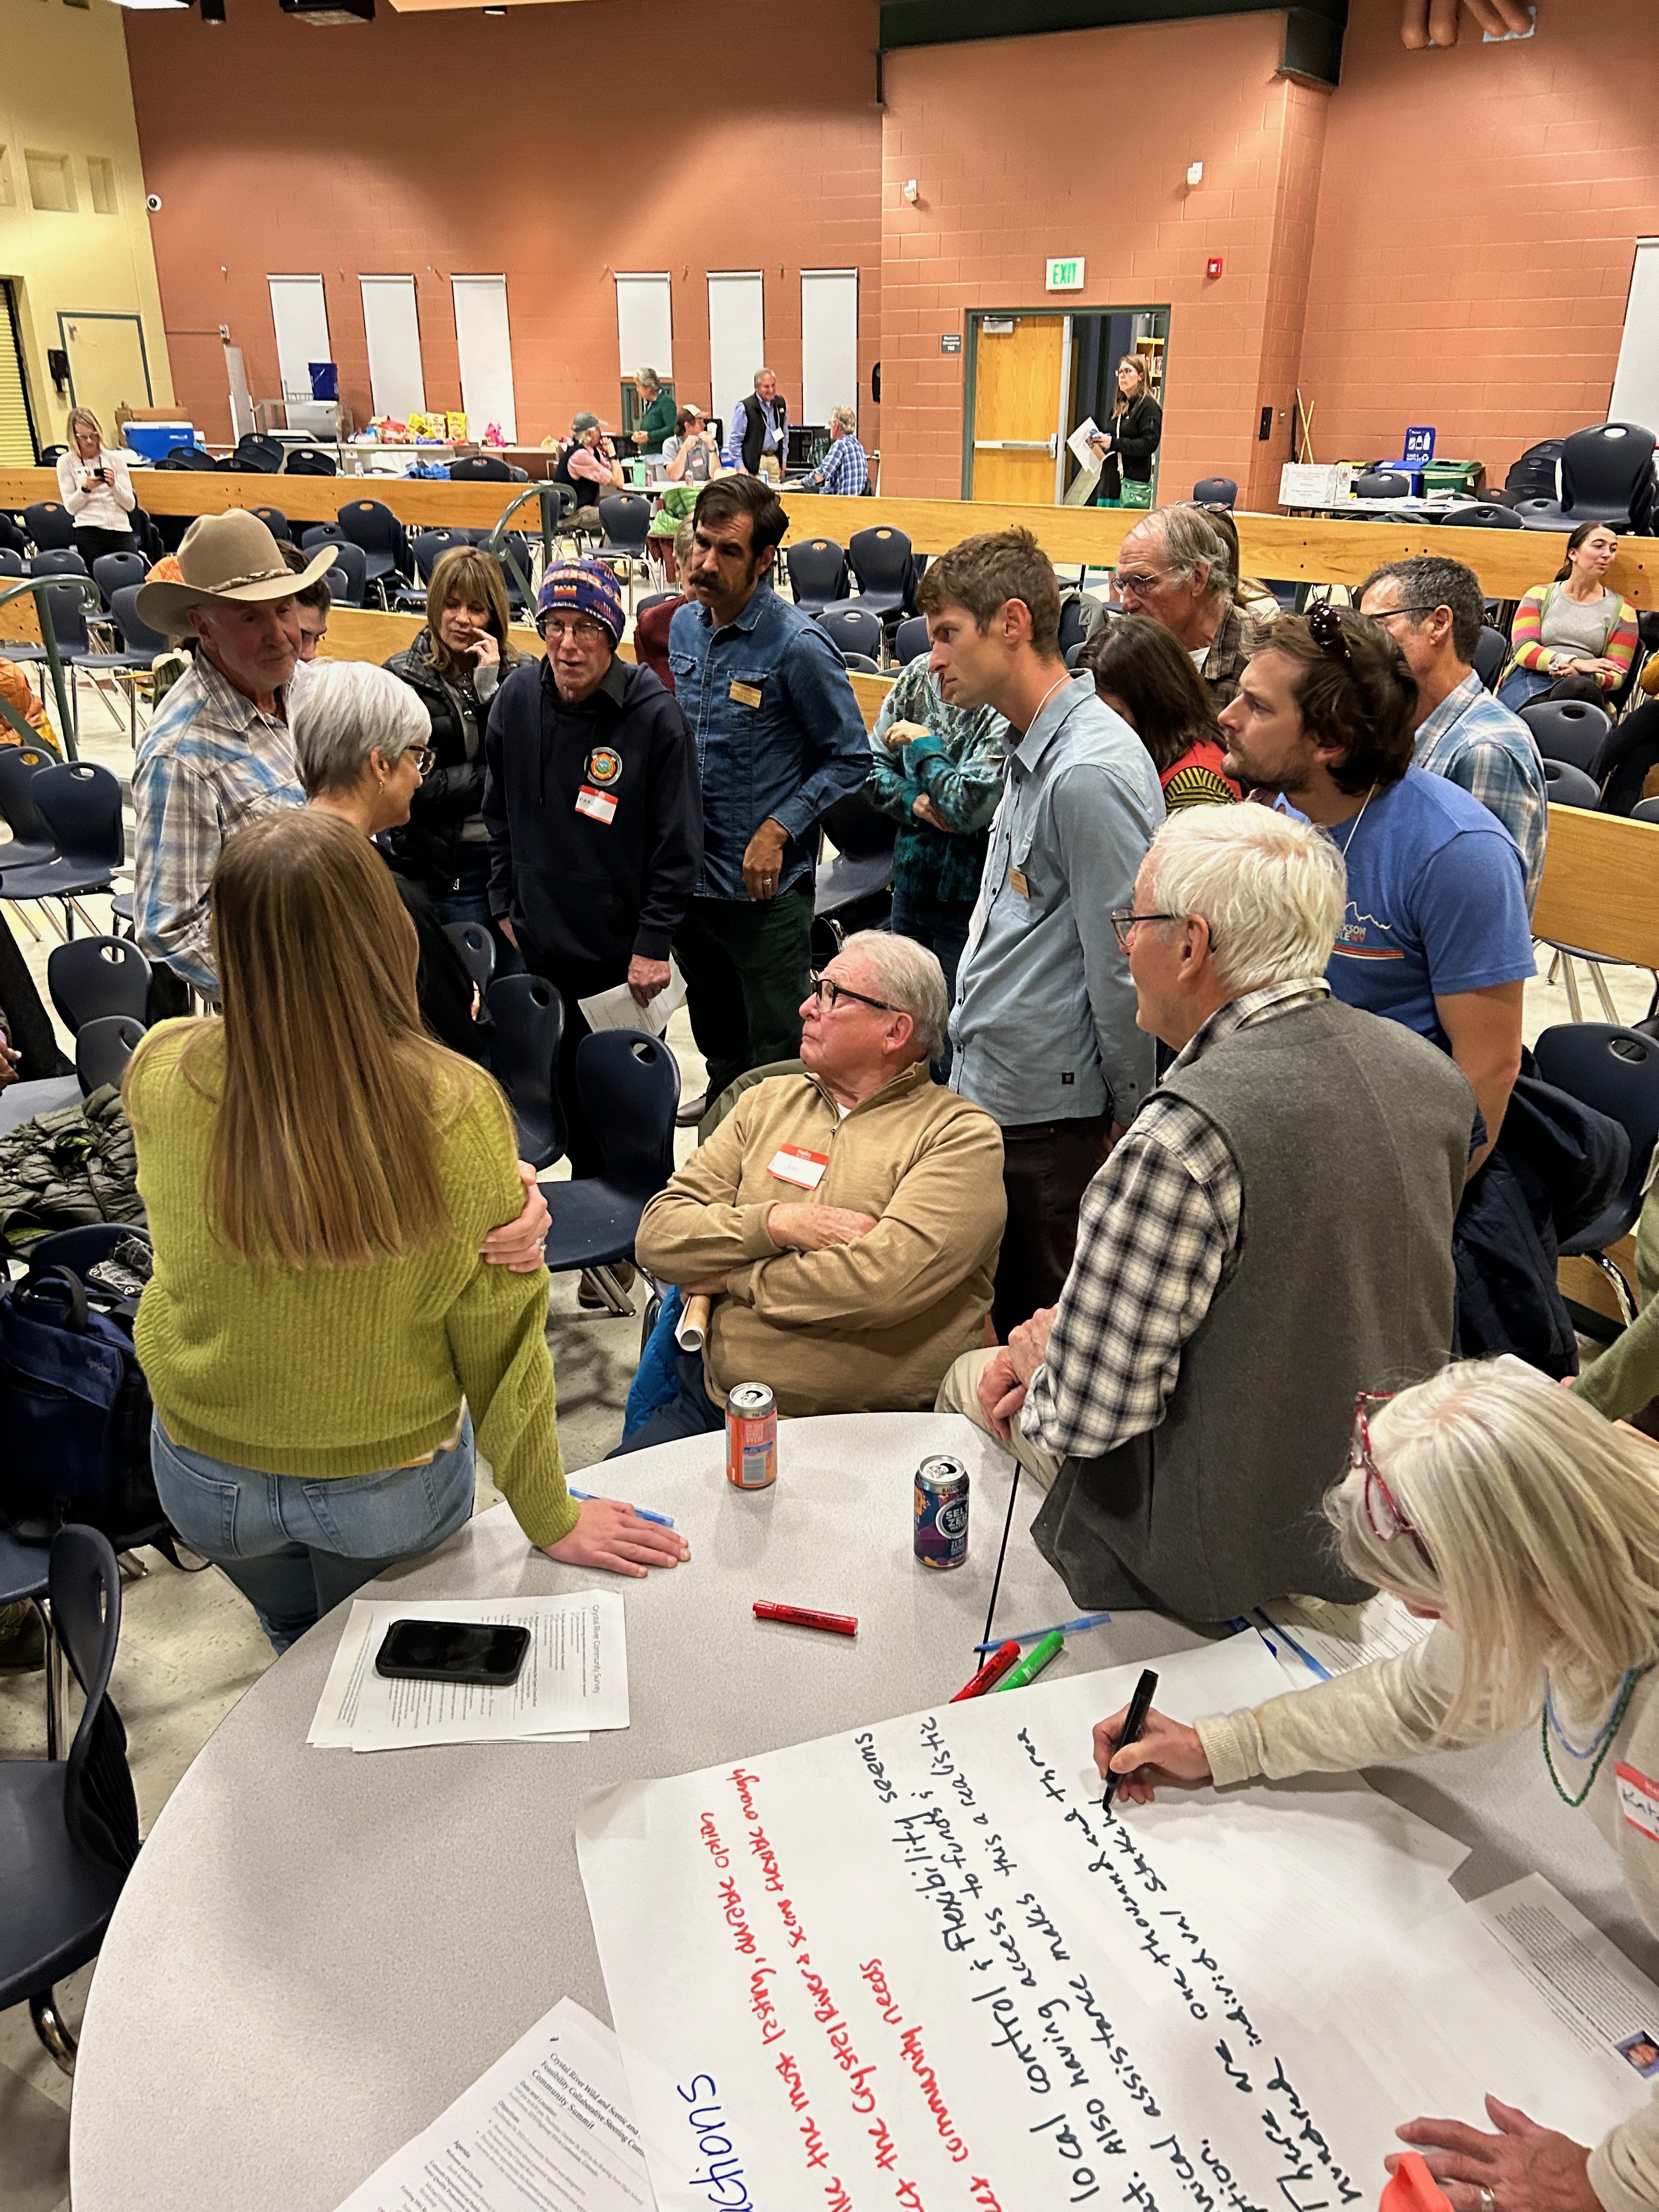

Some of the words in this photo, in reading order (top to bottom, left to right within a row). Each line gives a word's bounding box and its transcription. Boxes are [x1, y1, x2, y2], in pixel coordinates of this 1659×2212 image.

[1053, 263, 1077, 284] EXIT
[797, 1148, 812, 1158] Hello
[592, 1640, 601, 1672] Community
[592, 1673, 601, 1694] Survey
[854, 1733, 898, 1803] seems
[921, 1716, 976, 1806] realistic
[726, 1768, 760, 1820] enough
[973, 1812, 989, 1825] a
[700, 1812, 730, 1868] option
[748, 1826, 785, 1892] flexible
[923, 1807, 967, 1869] funds
[985, 1833, 1018, 1876] this
[891, 1811, 975, 1952] flexibility
[959, 1872, 983, 1899] to
[718, 1875, 757, 1954] durable
[1016, 1893, 1070, 1961] makes
[985, 1907, 1037, 1987] access
[801, 1969, 839, 2023] River
[859, 1957, 903, 2025] needs
[826, 2022, 877, 2113] Crystal
[972, 1985, 1051, 2094] control
[1038, 1998, 1090, 2087] having
[1068, 1973, 1161, 2117] assistance
[532, 2069, 568, 2106] Community
[567, 2103, 595, 2130] Summit
[541, 2059, 569, 2090] Feasibility
[568, 2086, 605, 2123] Collaborative
[604, 2118, 629, 2143] Steering
[550, 2052, 571, 2074] Crystal
[569, 2070, 585, 2087] River
[585, 2084, 599, 2100] Wild
[597, 2096, 611, 2109] and
[608, 2106, 628, 2126] Scenic
[775, 2052, 810, 2112] most
[900, 2025, 969, 2163] community
[799, 2116, 830, 2168] the
[868, 2117, 898, 2171] the
[1029, 2113, 1101, 2203] local
[1086, 2099, 1127, 2154] Also
